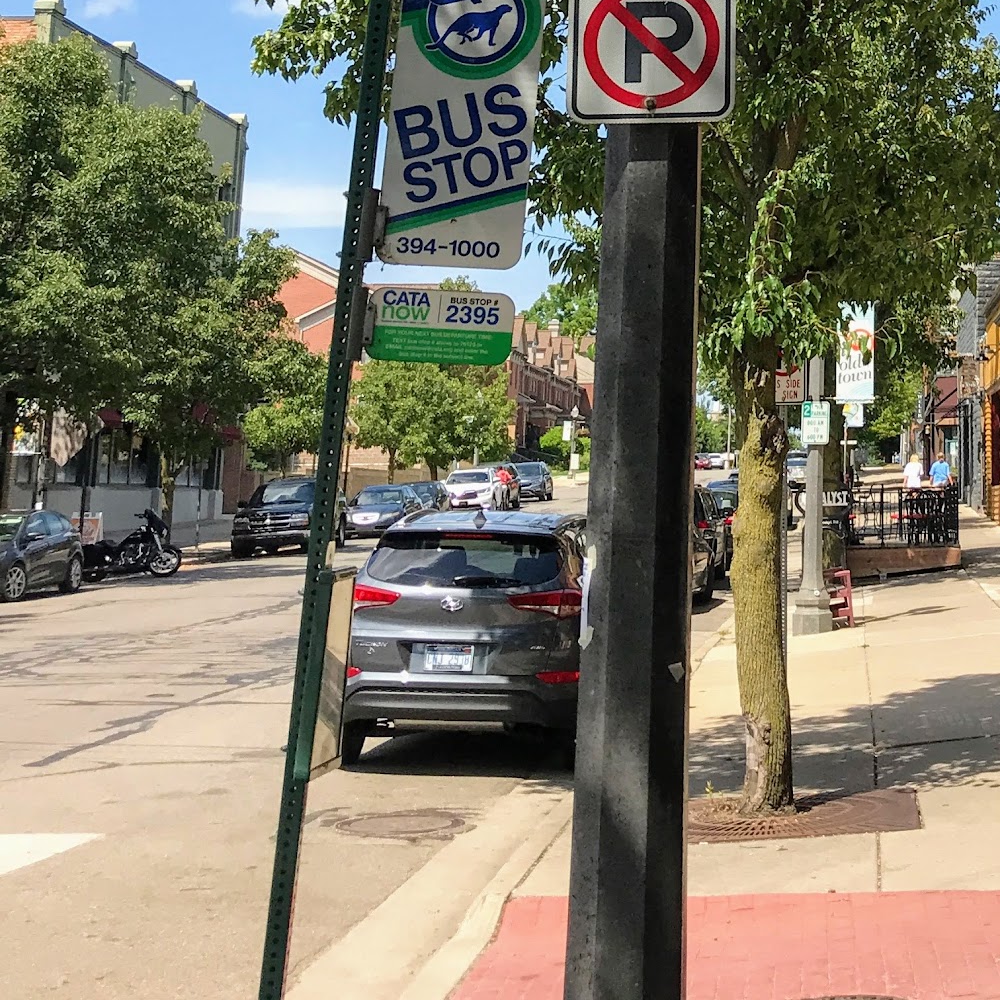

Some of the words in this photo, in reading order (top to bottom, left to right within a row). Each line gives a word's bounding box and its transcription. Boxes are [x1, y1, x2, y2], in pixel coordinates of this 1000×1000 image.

[394, 83, 528, 160] BUS
[403, 139, 529, 203] STOP
[396, 236, 501, 260] 394-1000
[383, 289, 431, 307] CATA
[450, 297, 468, 305] BUS
[469, 298, 491, 306] STOP
[382, 306, 431, 321] now
[445, 305, 500, 325] 2395
[840, 353, 862, 371] old
[785, 379, 801, 388] SIDE
[838, 370, 872, 384] town
[782, 390, 798, 400] SIGN
[804, 404, 811, 416] 2
